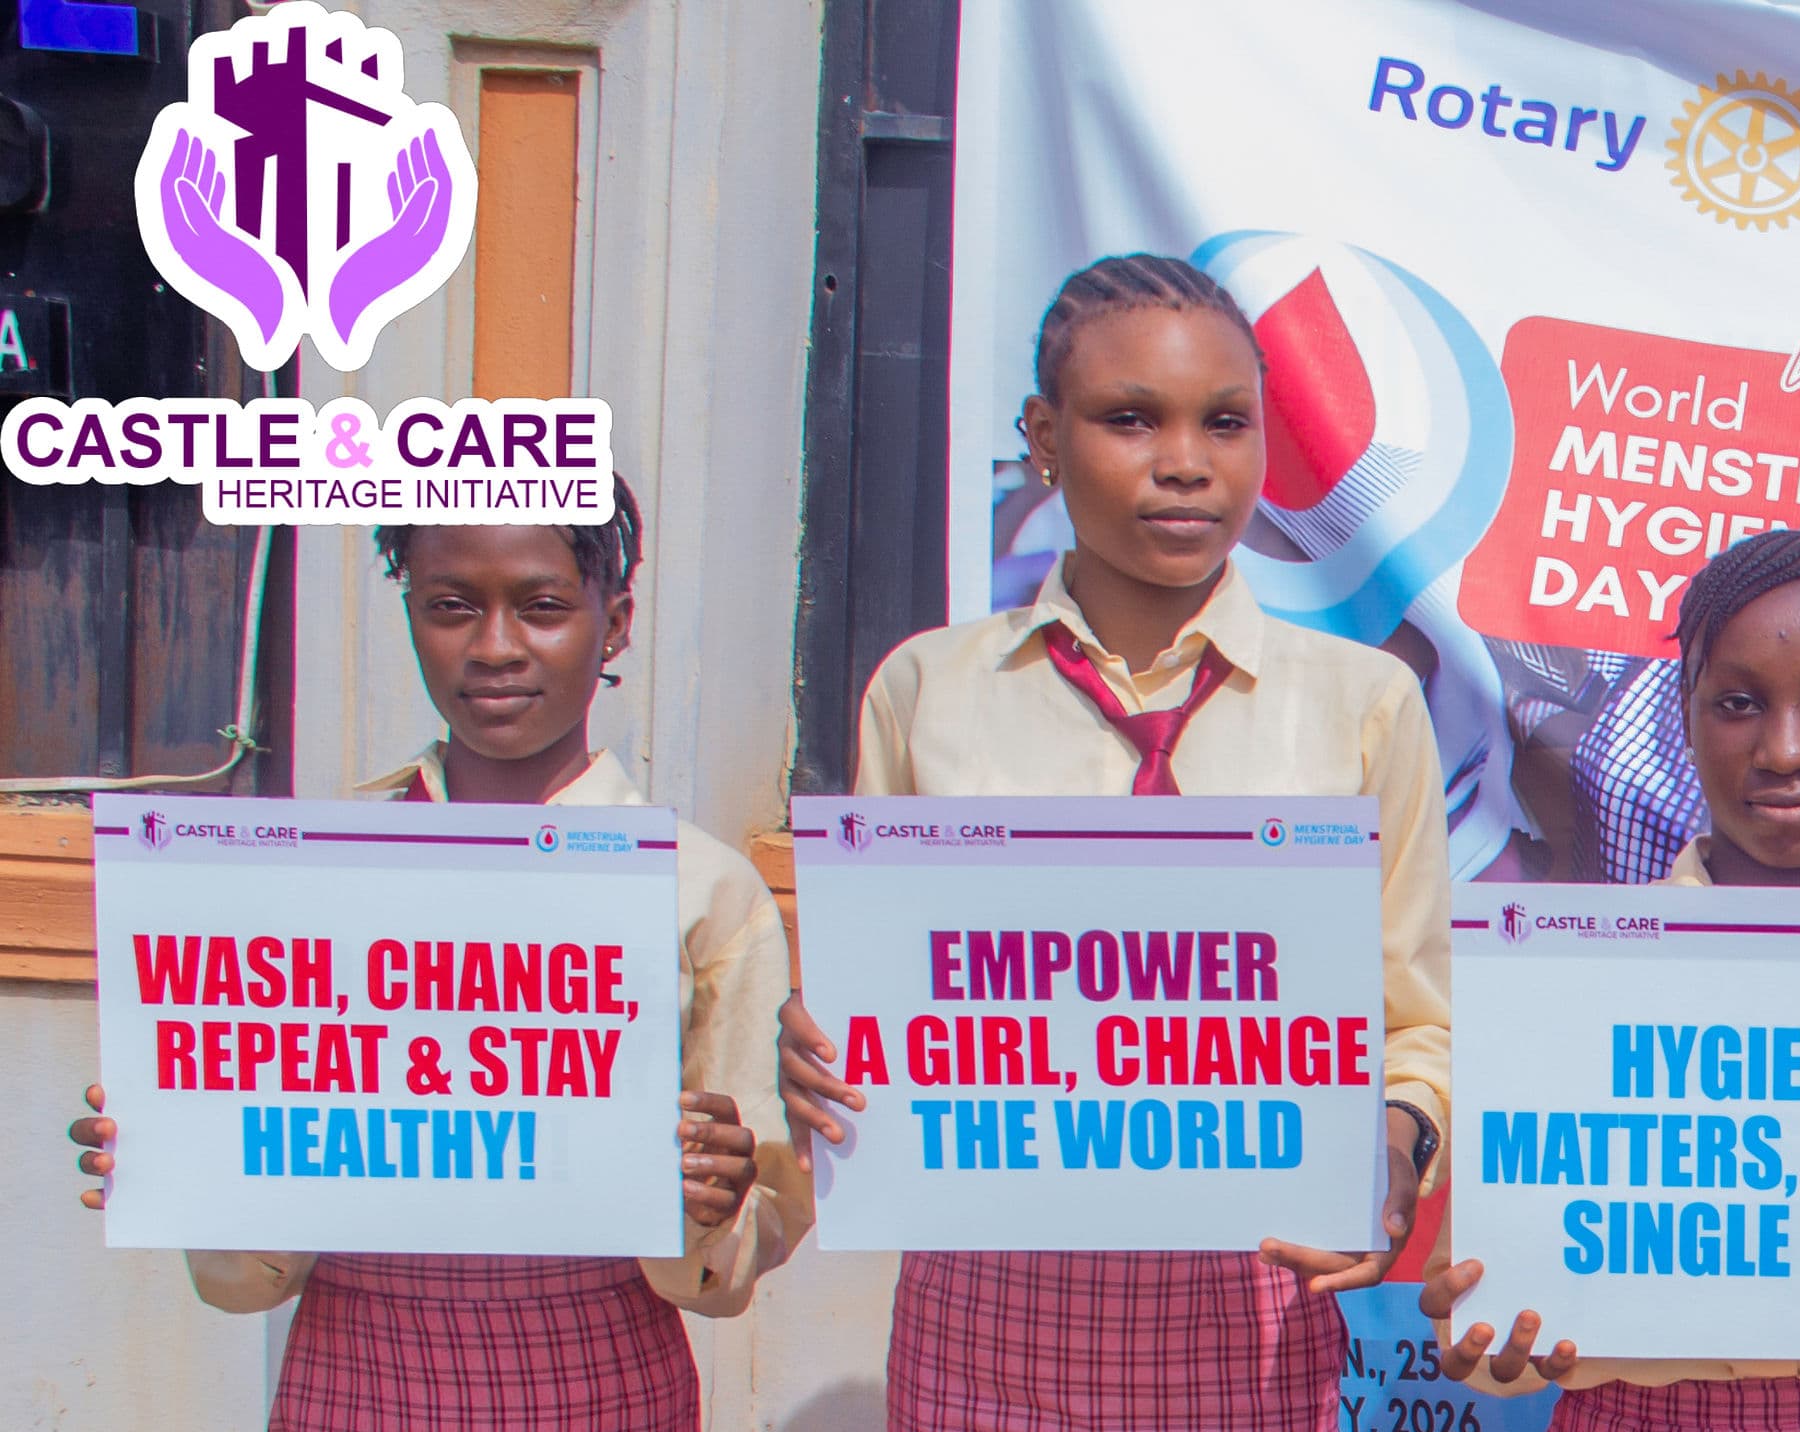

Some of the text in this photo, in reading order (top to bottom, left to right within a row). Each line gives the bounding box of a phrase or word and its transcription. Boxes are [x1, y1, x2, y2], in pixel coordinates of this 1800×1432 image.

[1367, 56, 1647, 171] Rotary
[1567, 359, 1748, 431] World
[1528, 556, 1687, 621] DAY
[175, 824, 235, 838] CASTLE
[255, 826, 298, 839] CARE
[876, 825, 939, 838] CASTLE
[960, 825, 1006, 838] CARE
[1535, 916, 1596, 930] CASTLE
[1616, 917, 1659, 931] CARE
[132, 934, 639, 1022] WASH, CHANGE,
[929, 930, 1279, 1002] EMPOWER
[156, 1020, 621, 1098] REPEAT & STAY
[844, 1015, 1370, 1093] A GIRL, CHANGE
[242, 1106, 536, 1180] HEALTHY!
[911, 1099, 1303, 1169] THE WORLD
[1482, 1111, 1798, 1198] MATTERS,
[1563, 1200, 1790, 1278] SINGLE
